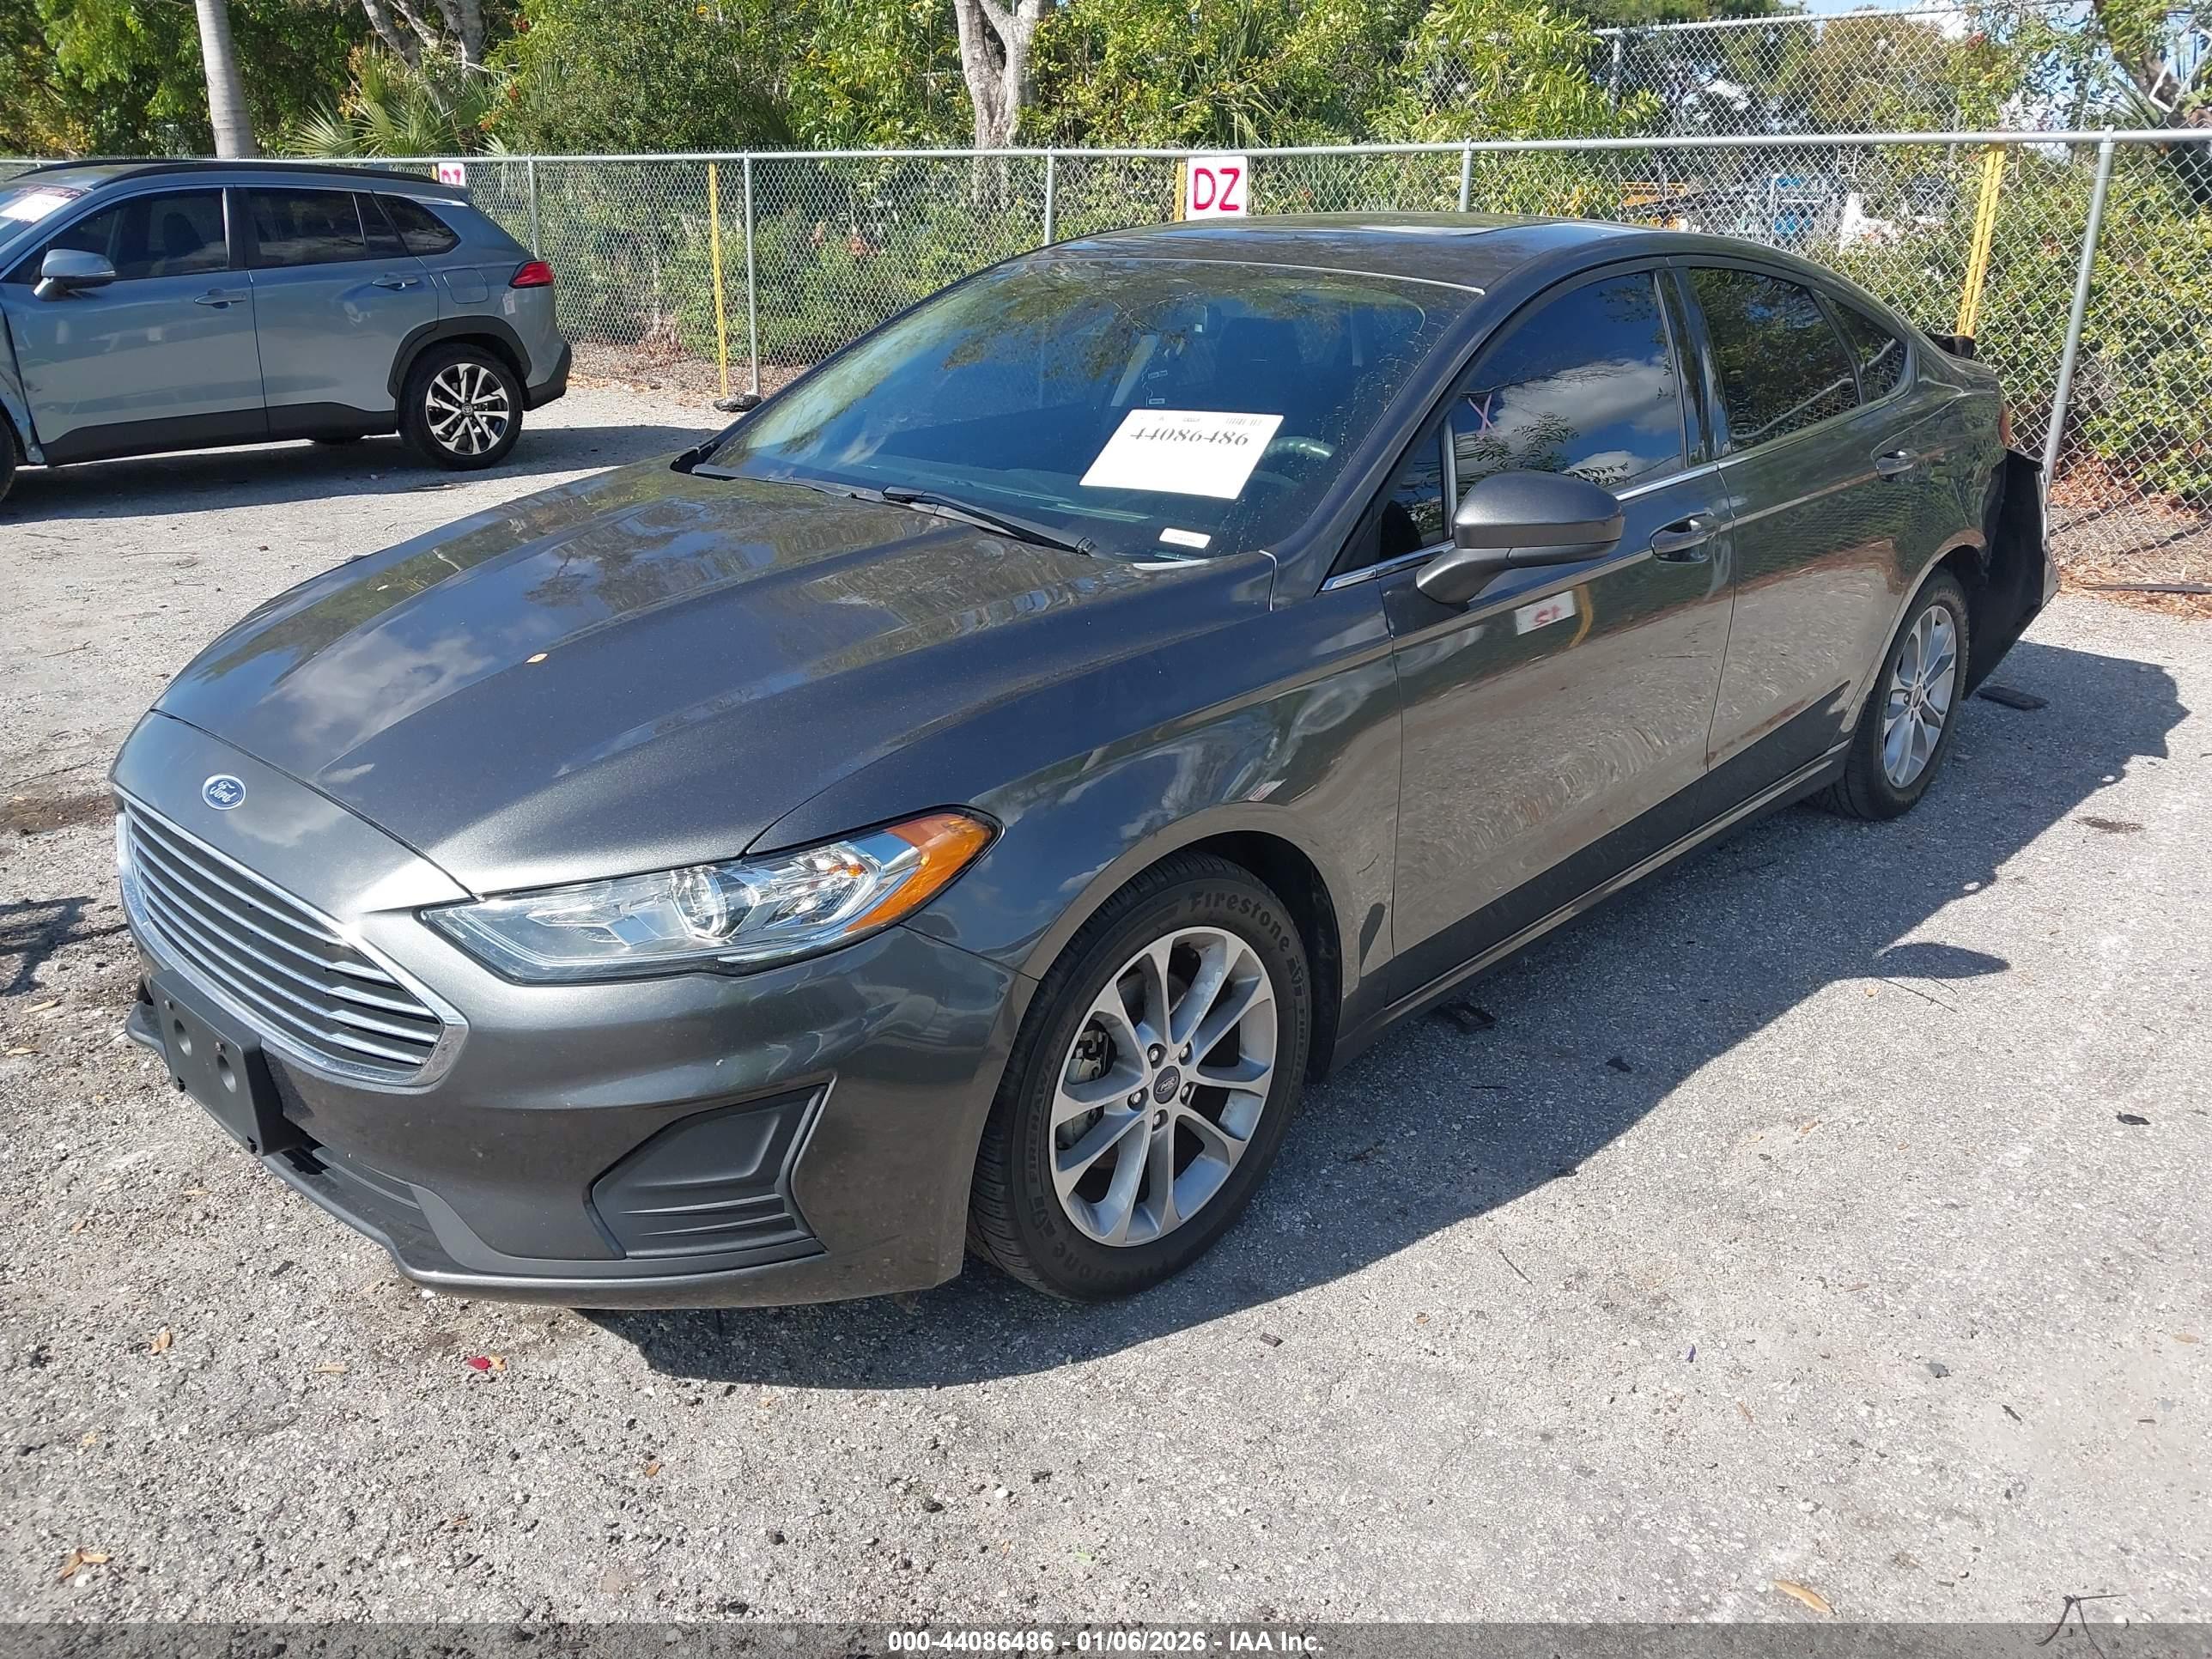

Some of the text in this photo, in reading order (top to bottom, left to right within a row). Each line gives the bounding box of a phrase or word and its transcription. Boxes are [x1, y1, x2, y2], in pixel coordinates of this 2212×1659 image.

[1194, 167, 1240, 211] DZ
[1130, 426, 1249, 447] 44086486
[209, 781, 237, 803] Ford
[1188, 891, 1291, 953] Firestone
